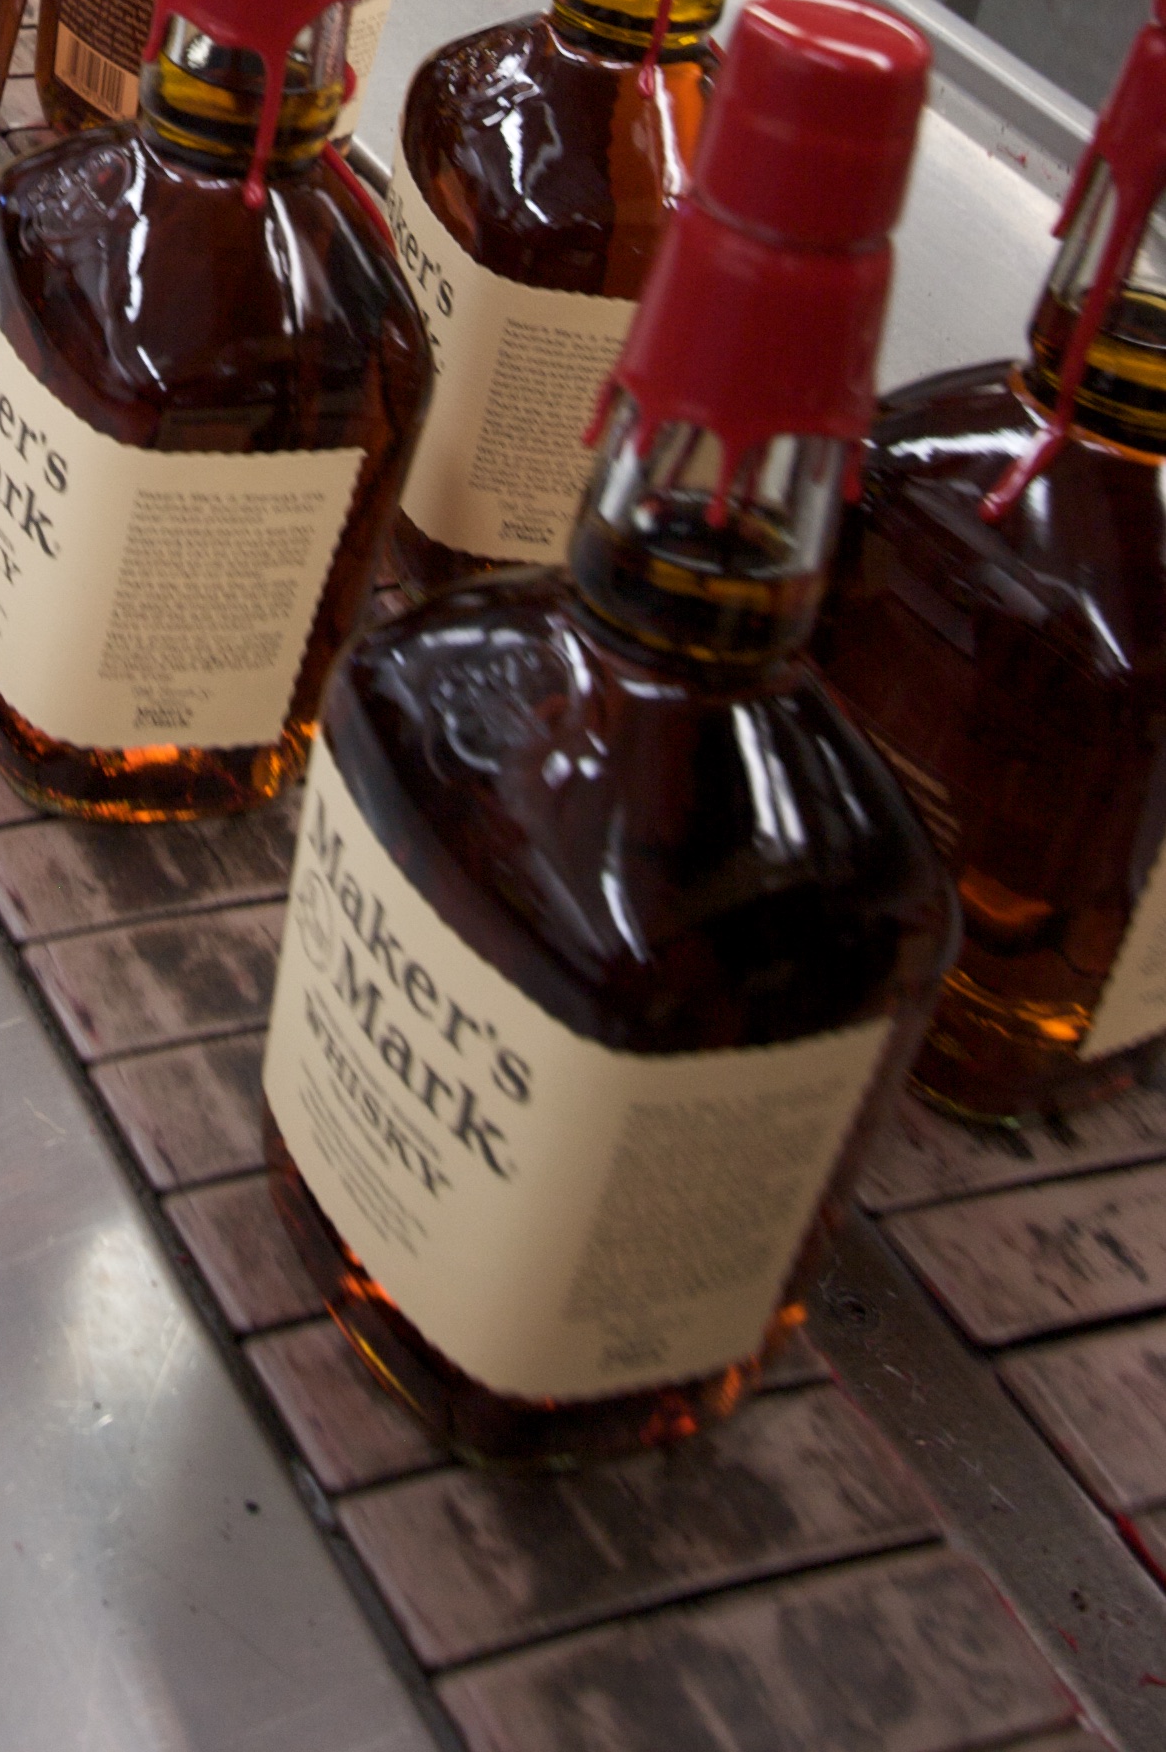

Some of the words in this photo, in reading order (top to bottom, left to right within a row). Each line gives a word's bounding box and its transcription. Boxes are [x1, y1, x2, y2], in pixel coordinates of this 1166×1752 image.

[308, 794, 534, 1106] Maker's
[332, 935, 513, 1184] Mark
[304, 988, 455, 1200] WHISKY
